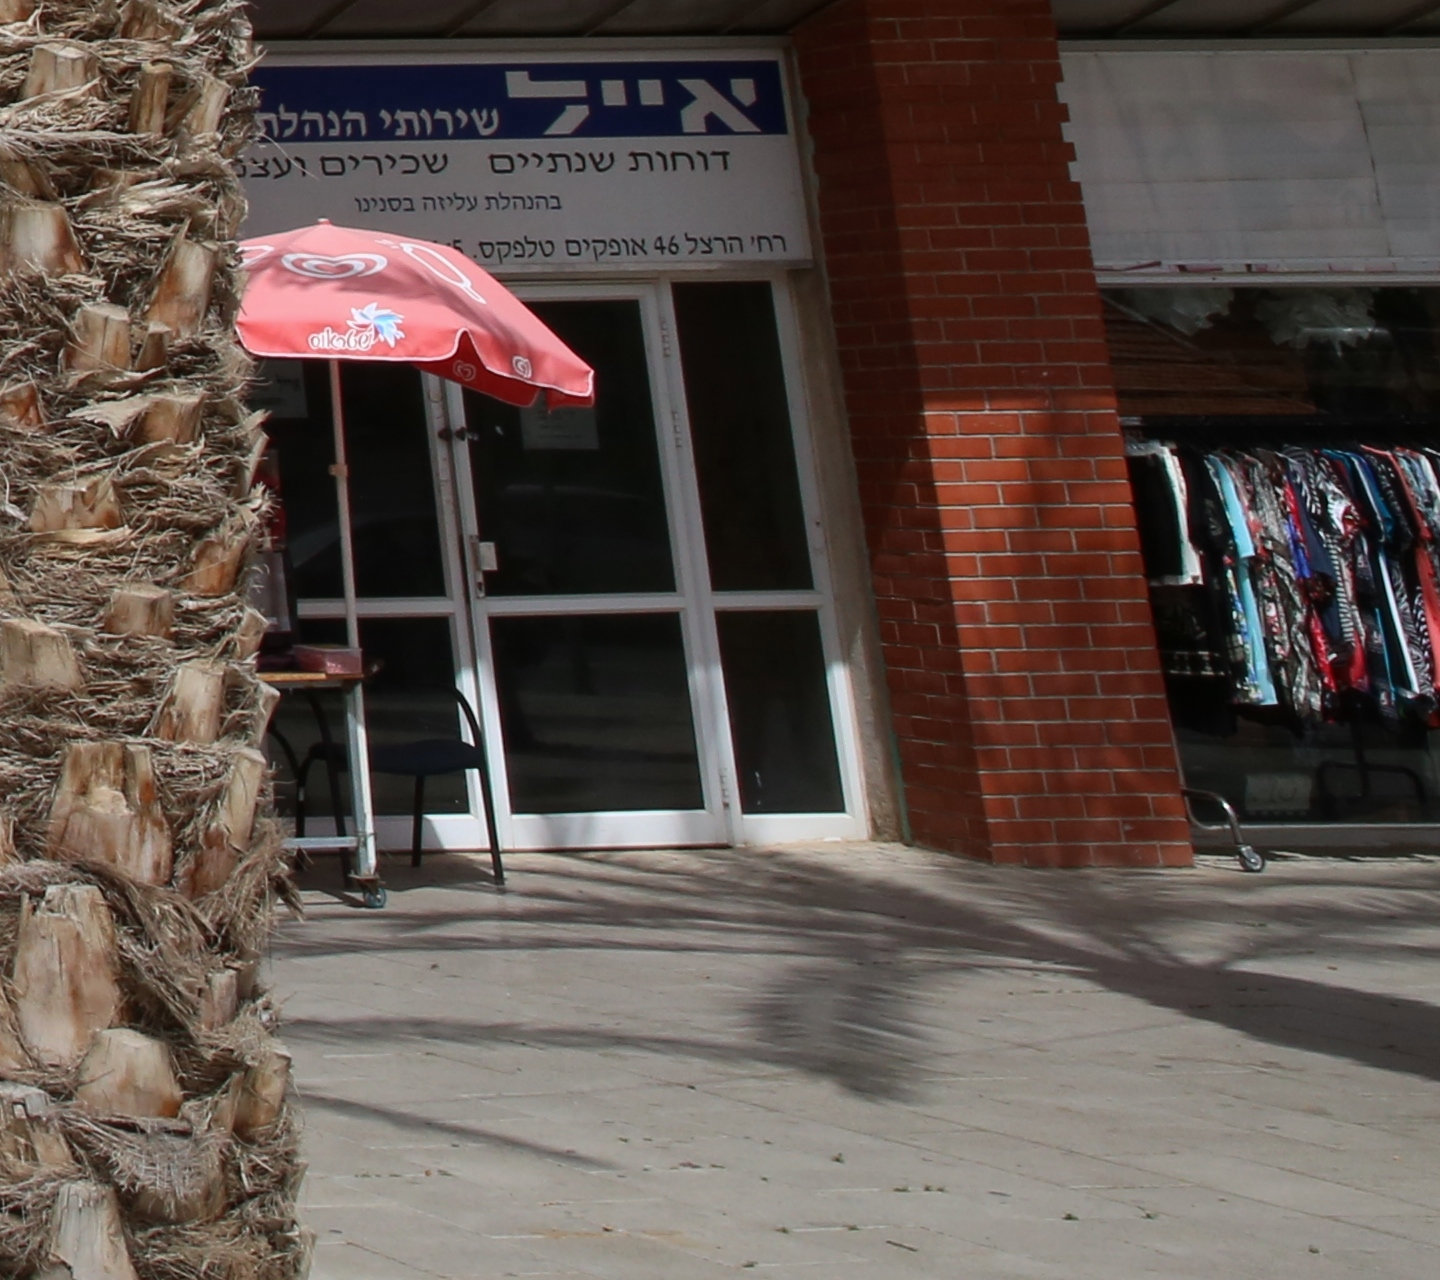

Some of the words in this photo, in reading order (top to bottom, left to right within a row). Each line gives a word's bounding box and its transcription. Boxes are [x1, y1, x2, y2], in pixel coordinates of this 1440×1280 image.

[504, 70, 762, 136] אייל
[379, 106, 500, 137] שירותי
[320, 152, 449, 176] שכירים
[489, 151, 615, 174] שנתיים
[628, 150, 731, 172] דוחות
[422, 192, 478, 212] עליזה
[484, 192, 563, 212] בהנהלת
[565, 237, 648, 262] אופקים
[653, 234, 680, 256] 46
[684, 232, 744, 255] הרצל
